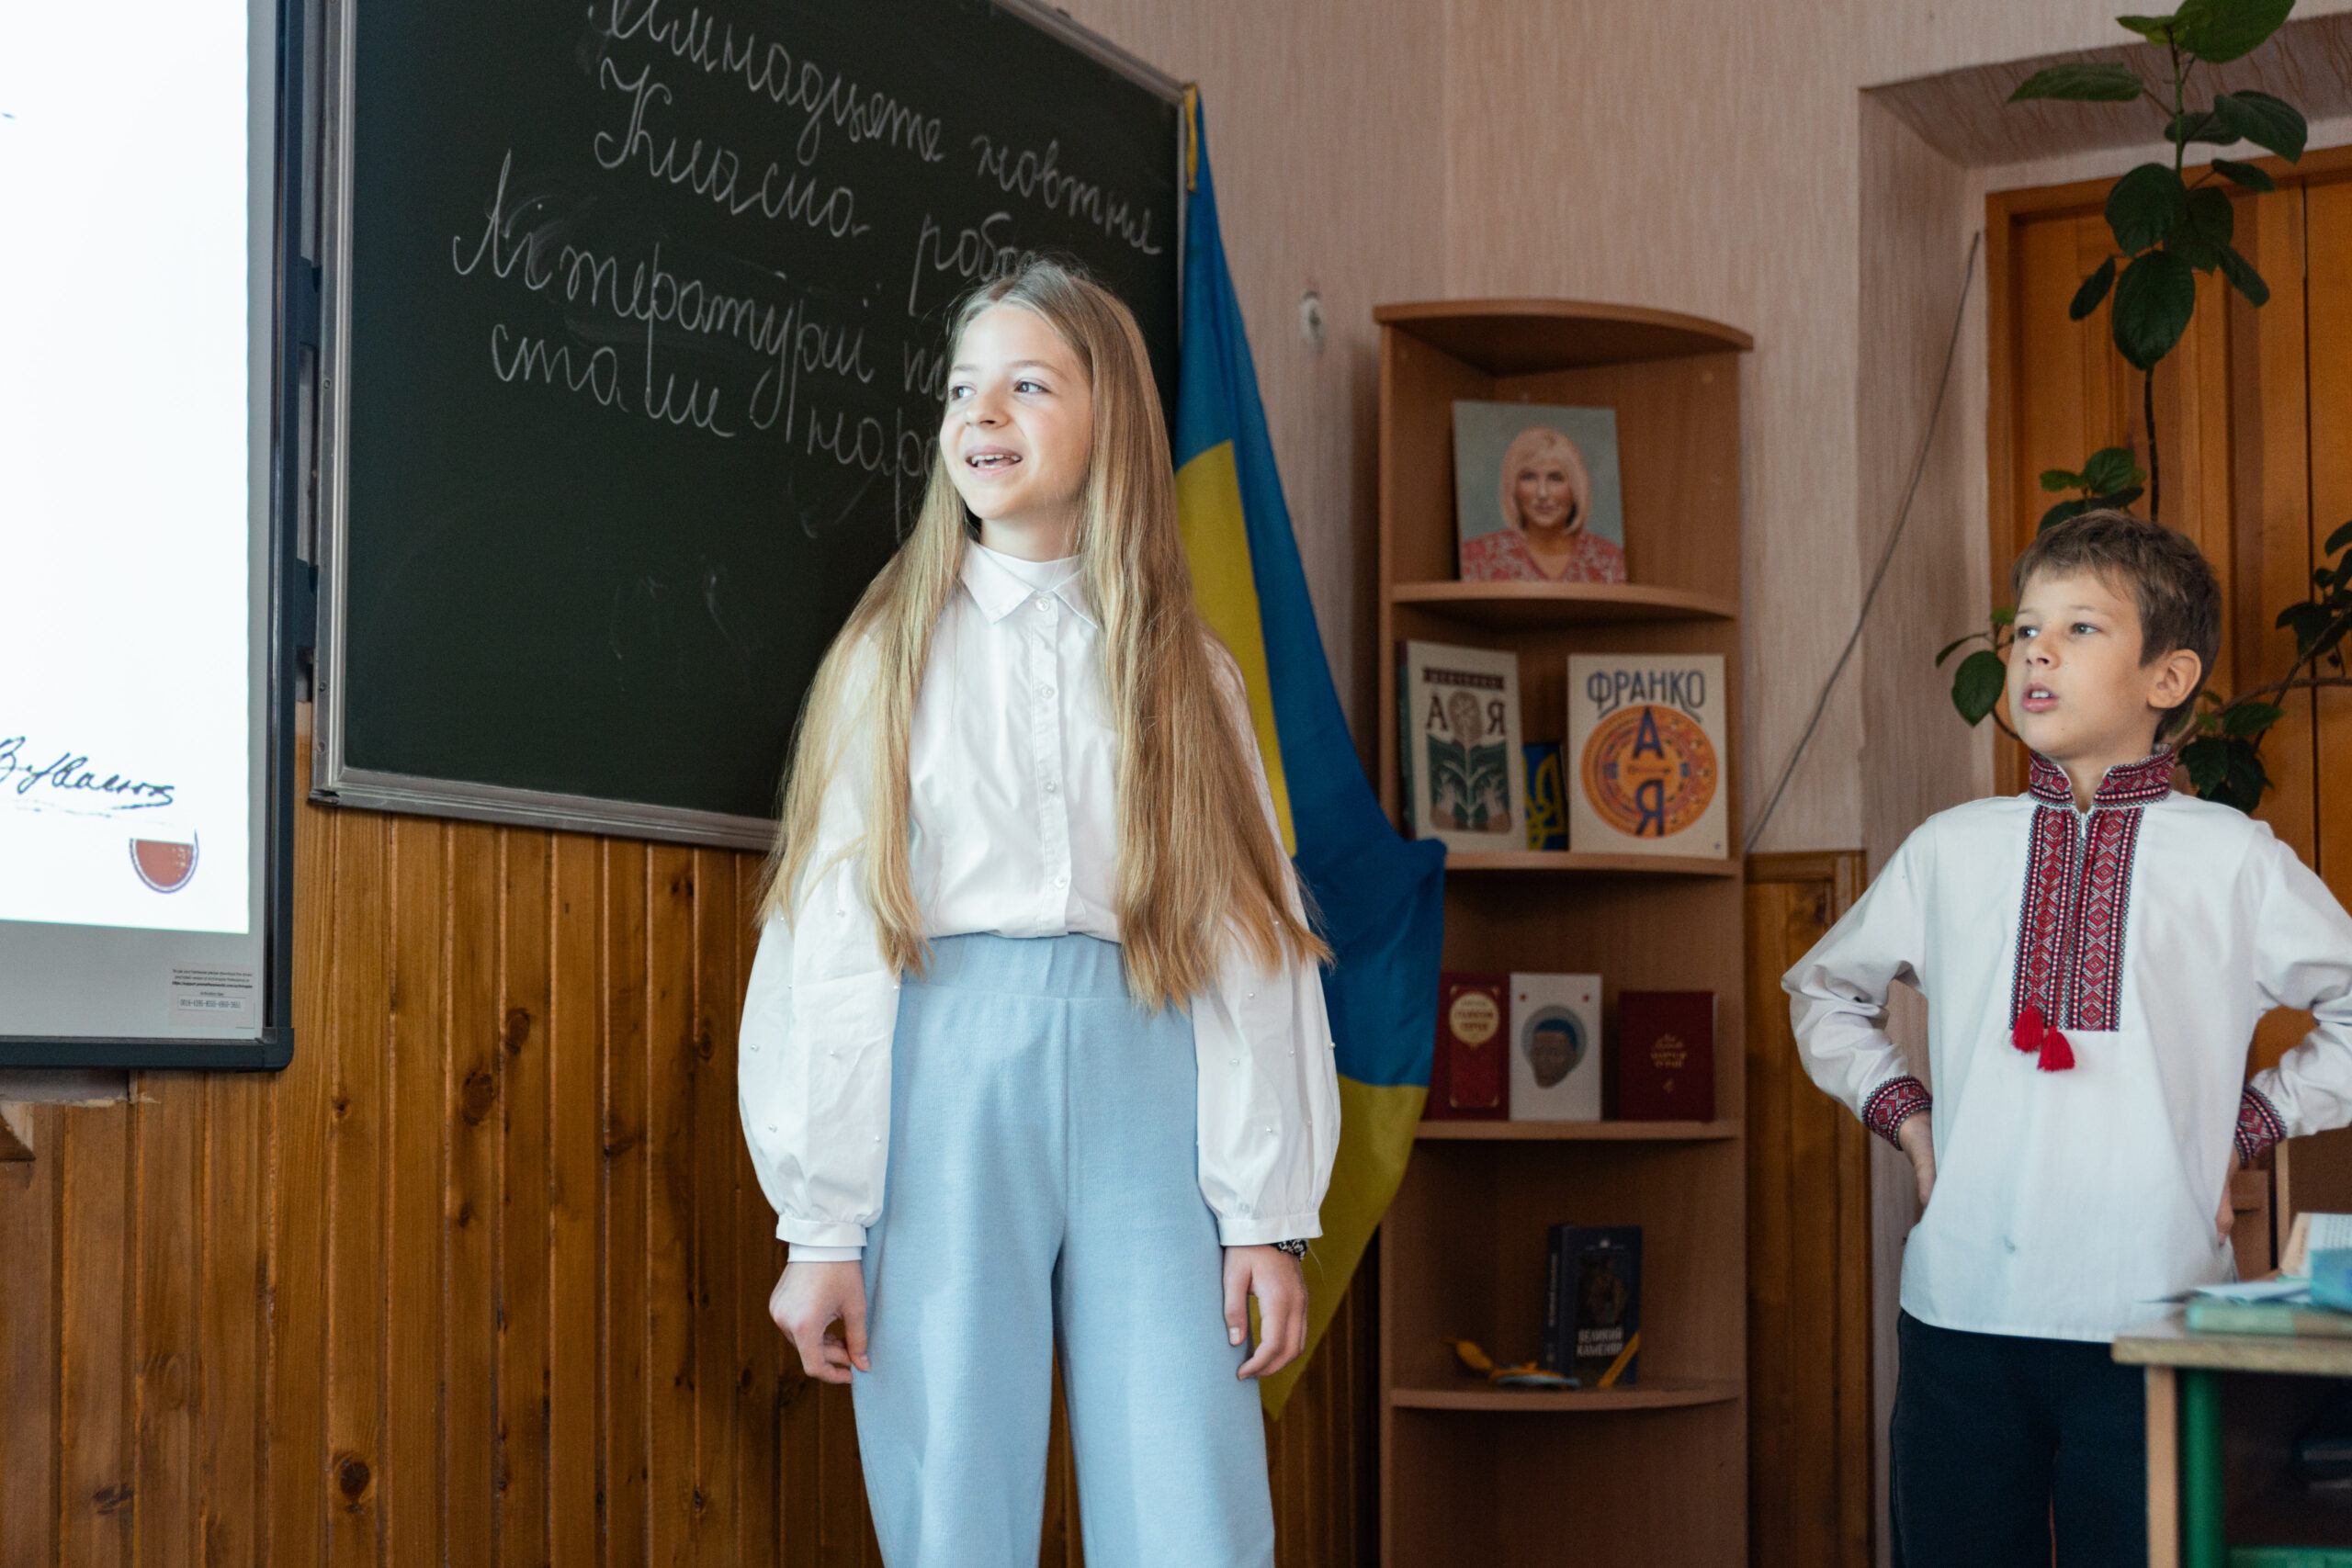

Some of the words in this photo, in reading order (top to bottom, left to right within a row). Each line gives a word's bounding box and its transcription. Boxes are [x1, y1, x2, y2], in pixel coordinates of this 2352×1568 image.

[594, 56, 871, 239] Класна
[969, 133, 1163, 255] жовтня
[1425, 694, 1449, 731] А
[1487, 700, 1506, 735] Я
[1587, 669, 1706, 722] ФРАНКО
[1633, 706, 1665, 761] А
[1635, 780, 1665, 837] Я
